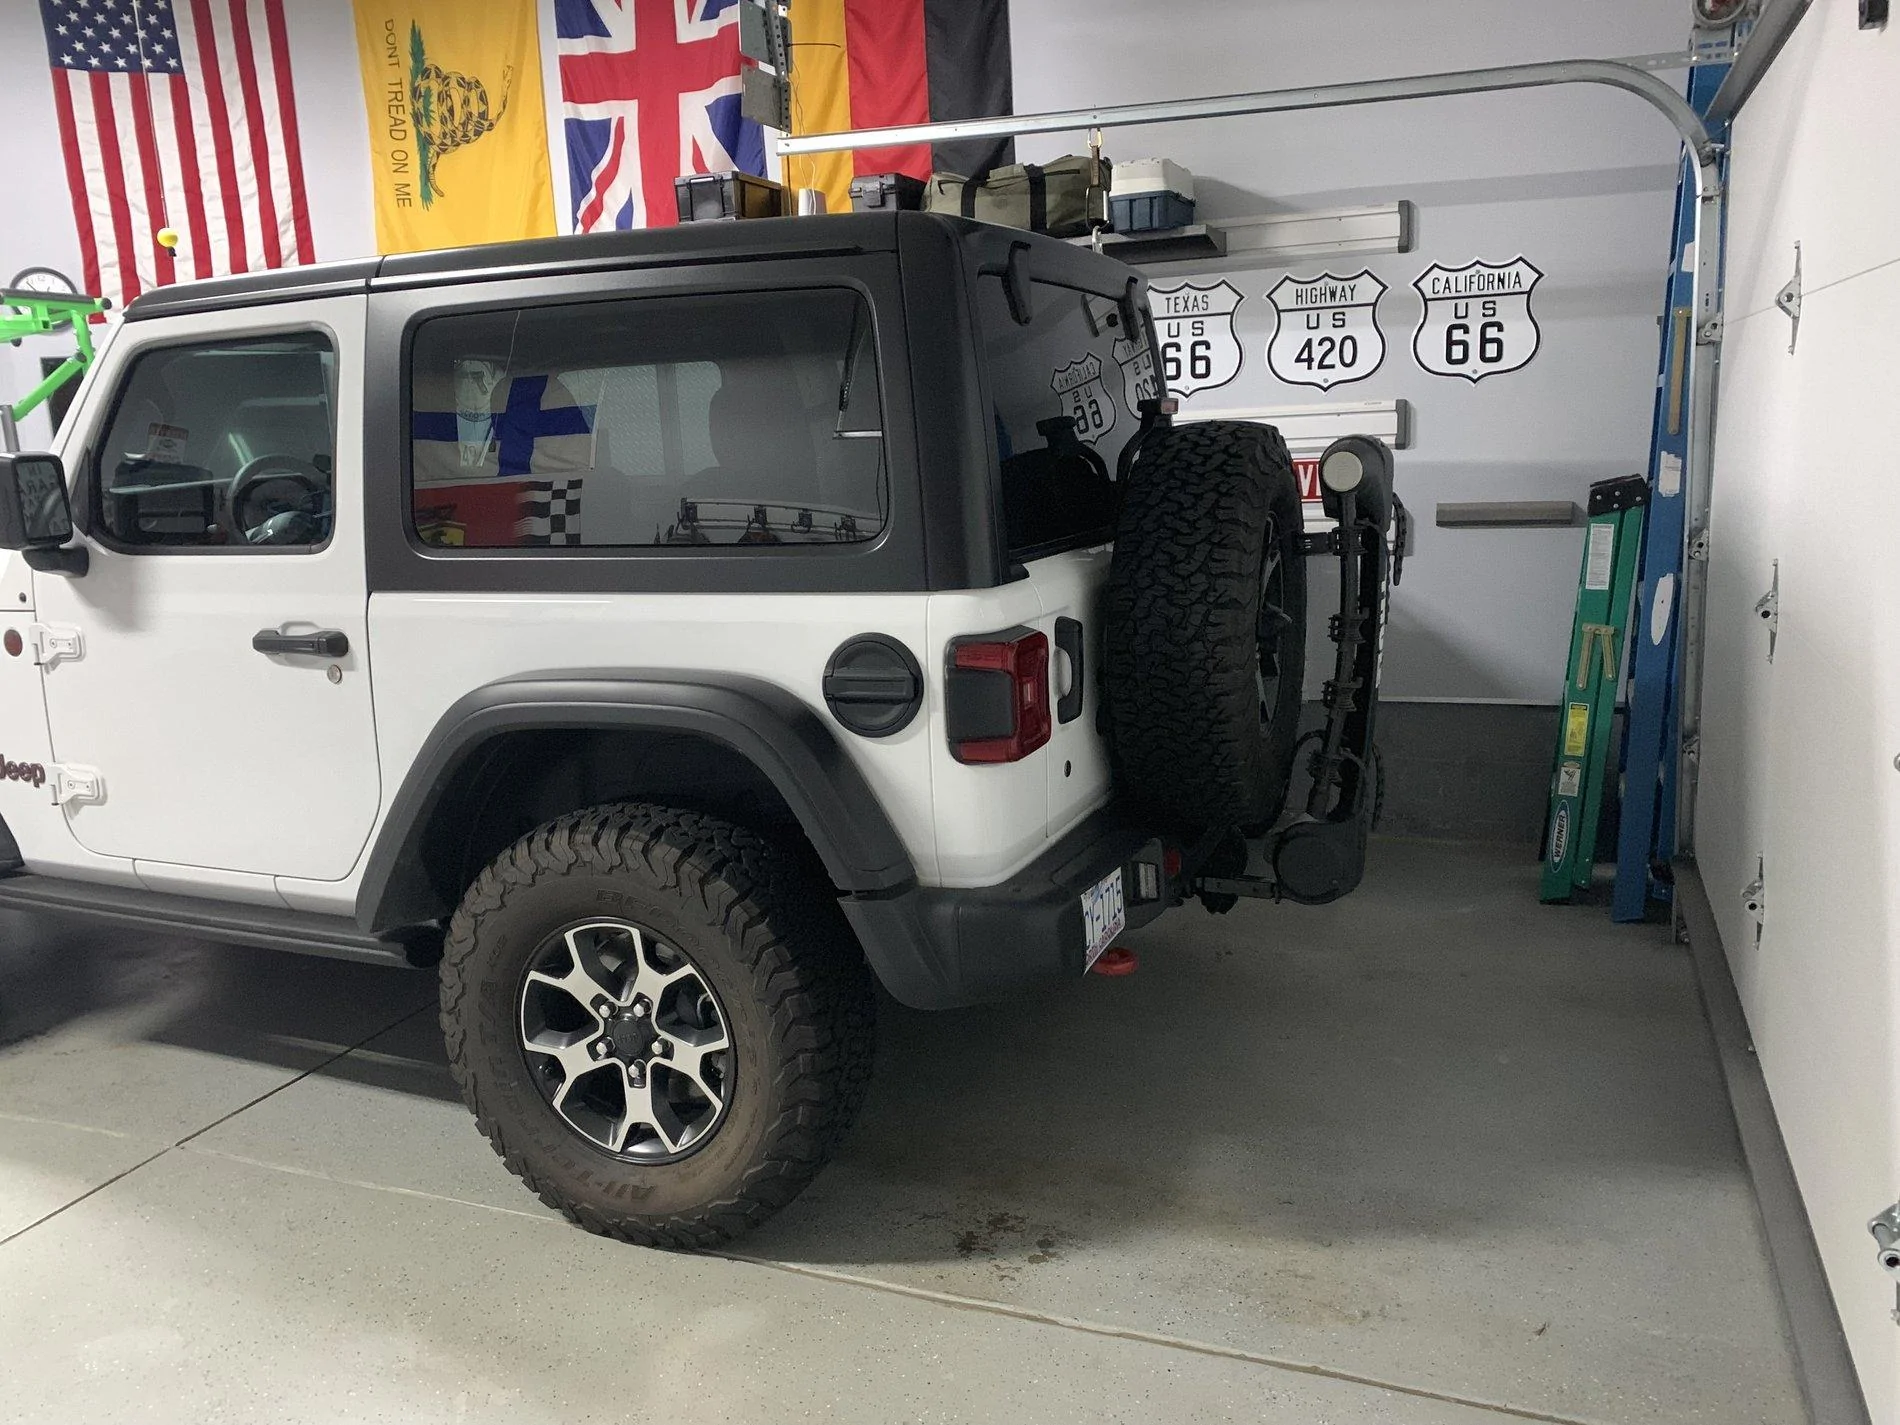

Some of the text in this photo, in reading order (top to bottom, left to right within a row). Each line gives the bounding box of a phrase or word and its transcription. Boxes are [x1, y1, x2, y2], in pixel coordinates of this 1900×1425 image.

[384, 18, 412, 208] DONT TREAD ON ME
[1295, 284, 1356, 305] HIGHWAY
[1432, 271, 1522, 294] CALIFORNIA
[1165, 294, 1209, 313] TEXAS
[1161, 340, 1211, 381] 66
[1294, 335, 1357, 371] 420
[1445, 321, 1504, 365] 66
[1553, 814, 1566, 858] WERNER
